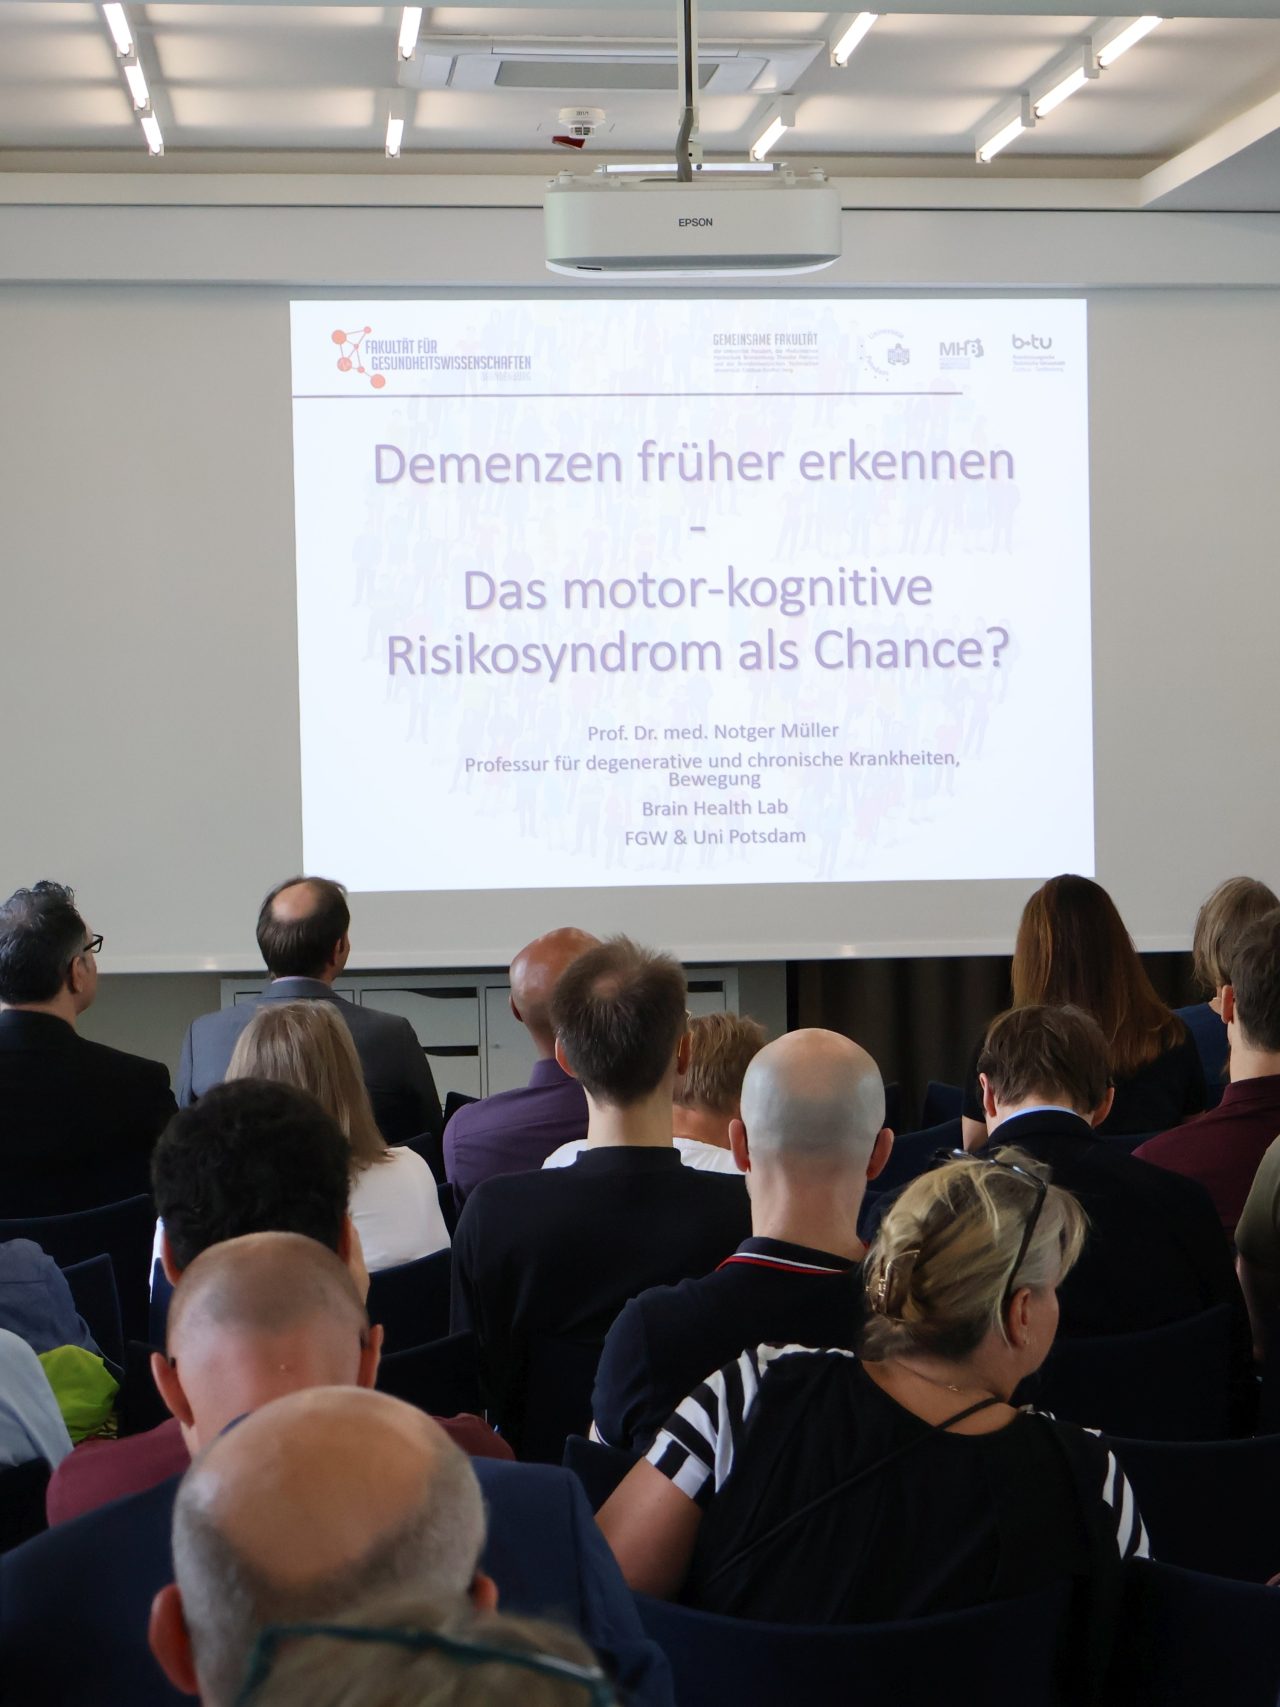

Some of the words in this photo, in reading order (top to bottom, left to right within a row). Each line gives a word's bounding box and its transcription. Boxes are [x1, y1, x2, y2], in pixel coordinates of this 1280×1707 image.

[679, 218, 713, 227] EPSON
[365, 337, 414, 354] FAKULTÄT
[418, 338, 438, 354] FÜR
[713, 333, 772, 346] GEMEINSAME
[775, 331, 818, 346] FAKULTÄT
[371, 355, 532, 371] GESUNDHEITSWISSENSCHAFTEN
[375, 443, 622, 485] Demenzen
[637, 439, 785, 483] früher
[799, 438, 1015, 482] erkennen
[464, 571, 548, 611] Das
[564, 565, 933, 617] motor-kognitive
[387, 630, 722, 683] Risikosyndrom
[738, 628, 800, 671] als
[814, 626, 1011, 670] Chance?
[587, 725, 629, 742] Prof.
[635, 726, 658, 741] Dr.
[663, 724, 709, 741] med.
[714, 724, 776, 743] Notger
[781, 722, 840, 739] Müller
[465, 756, 550, 773] Professur
[553, 754, 581, 771] für
[585, 752, 703, 775] degenerative
[708, 752, 742, 769] und
[747, 751, 844, 768] chronische
[849, 749, 960, 768] Krankheiten,
[668, 772, 761, 791] Bewegung
[642, 800, 688, 817] Brain
[693, 799, 752, 816] Health
[758, 798, 789, 815] Lab
[625, 831, 668, 846] FGW
[673, 830, 688, 846] &
[693, 828, 724, 845] Uni
[728, 827, 806, 845] Potsdam
